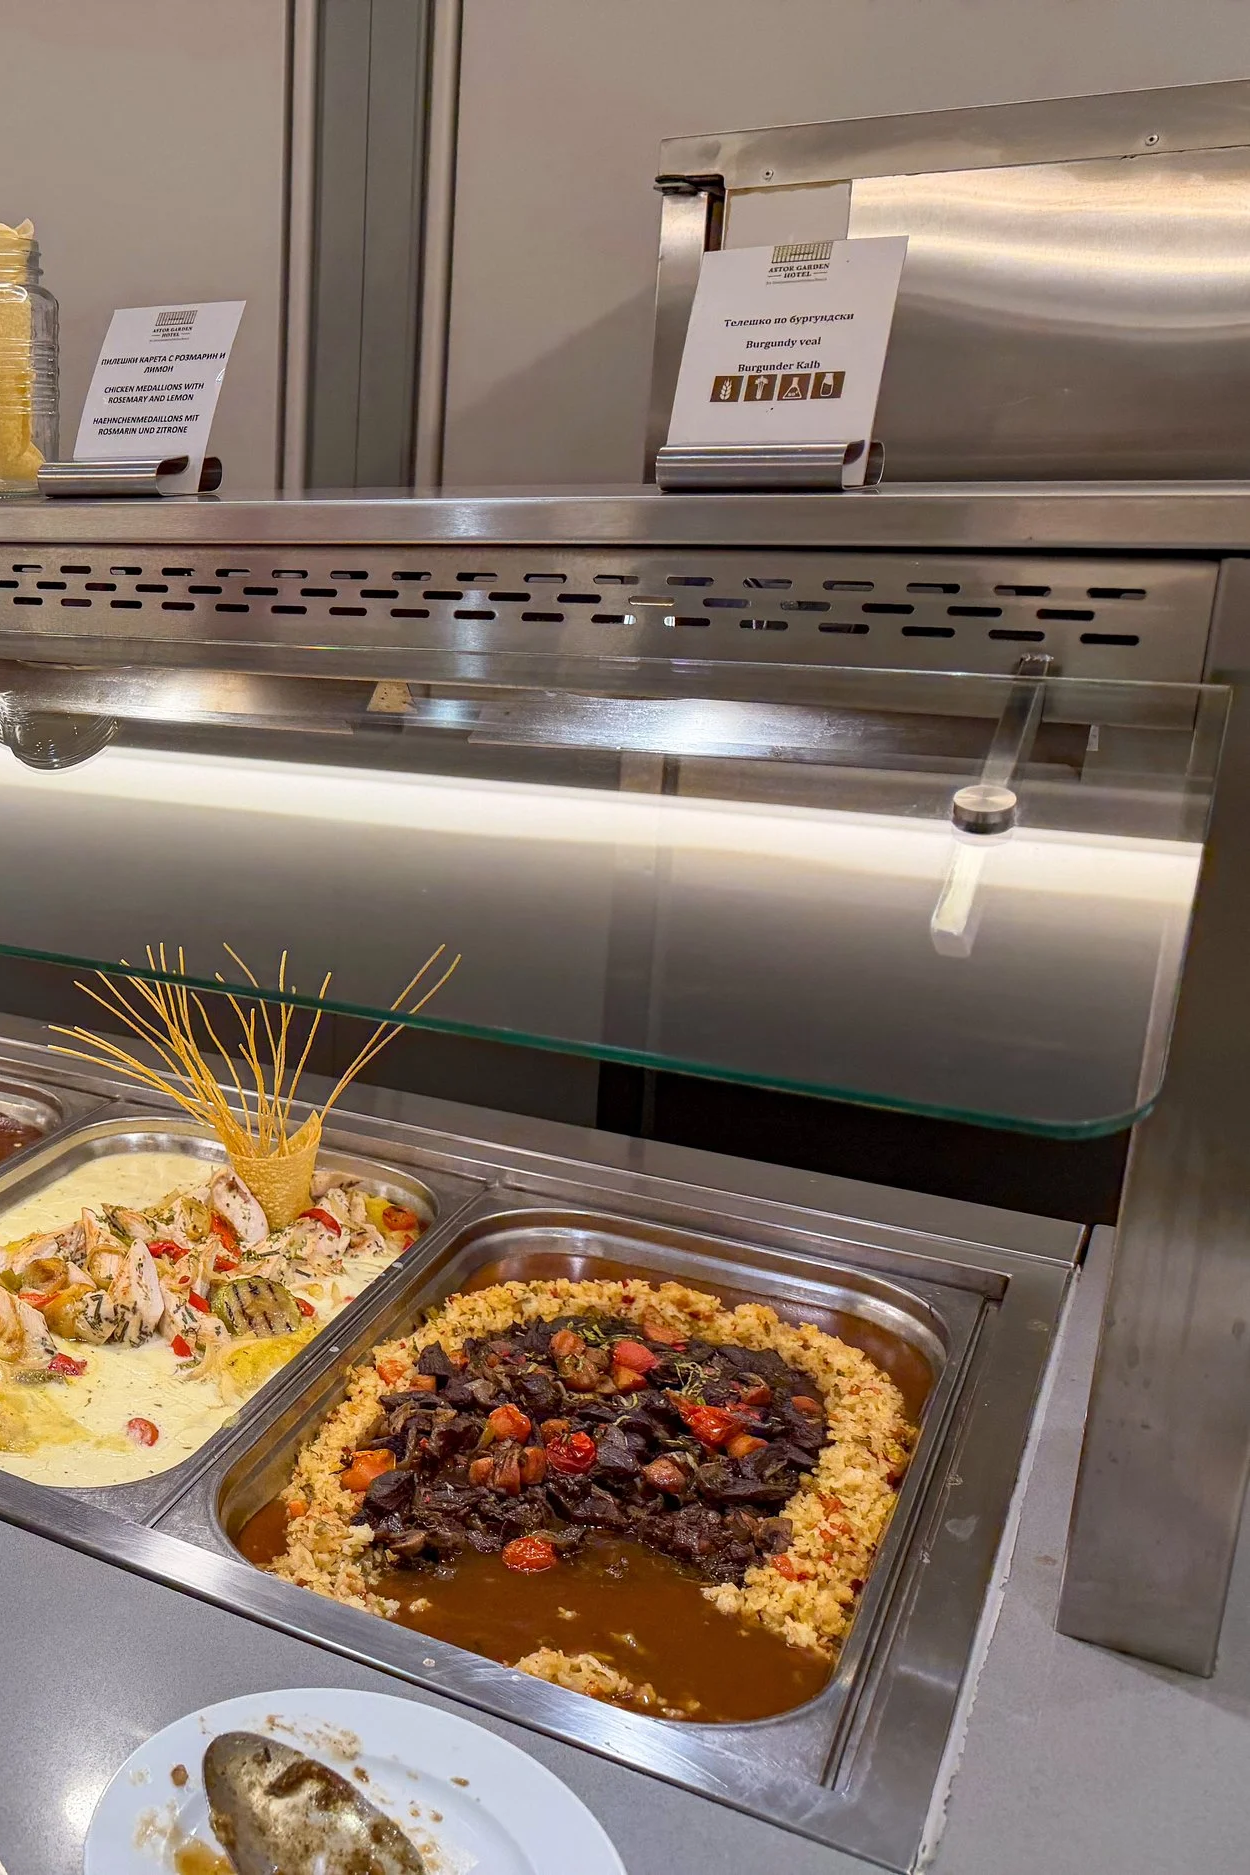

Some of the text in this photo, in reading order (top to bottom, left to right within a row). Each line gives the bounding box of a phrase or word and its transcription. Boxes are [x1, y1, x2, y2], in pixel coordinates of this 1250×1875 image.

[768, 263, 830, 273] ASTOR GARDEN
[783, 271, 812, 279] HOTEL
[724, 312, 855, 328] Телешко по бургундски
[746, 336, 822, 350] Burgundy veal
[101, 358, 138, 366] ПИЛЕШКИ
[139, 355, 167, 364] КАРЕТА
[174, 353, 219, 362] РОЗМАРИН
[143, 365, 174, 374] ЛИМОН
[738, 360, 821, 373] Burgunder Kalb
[104, 382, 205, 394] CHICKEN MEDALLIONS WITH
[108, 394, 194, 404] ROSEMARY AND LEMON
[93, 414, 200, 425] HAEHNCHENMEDAILLONS MIT
[98, 426, 188, 436] ROSMARIN UND ZITRONE
